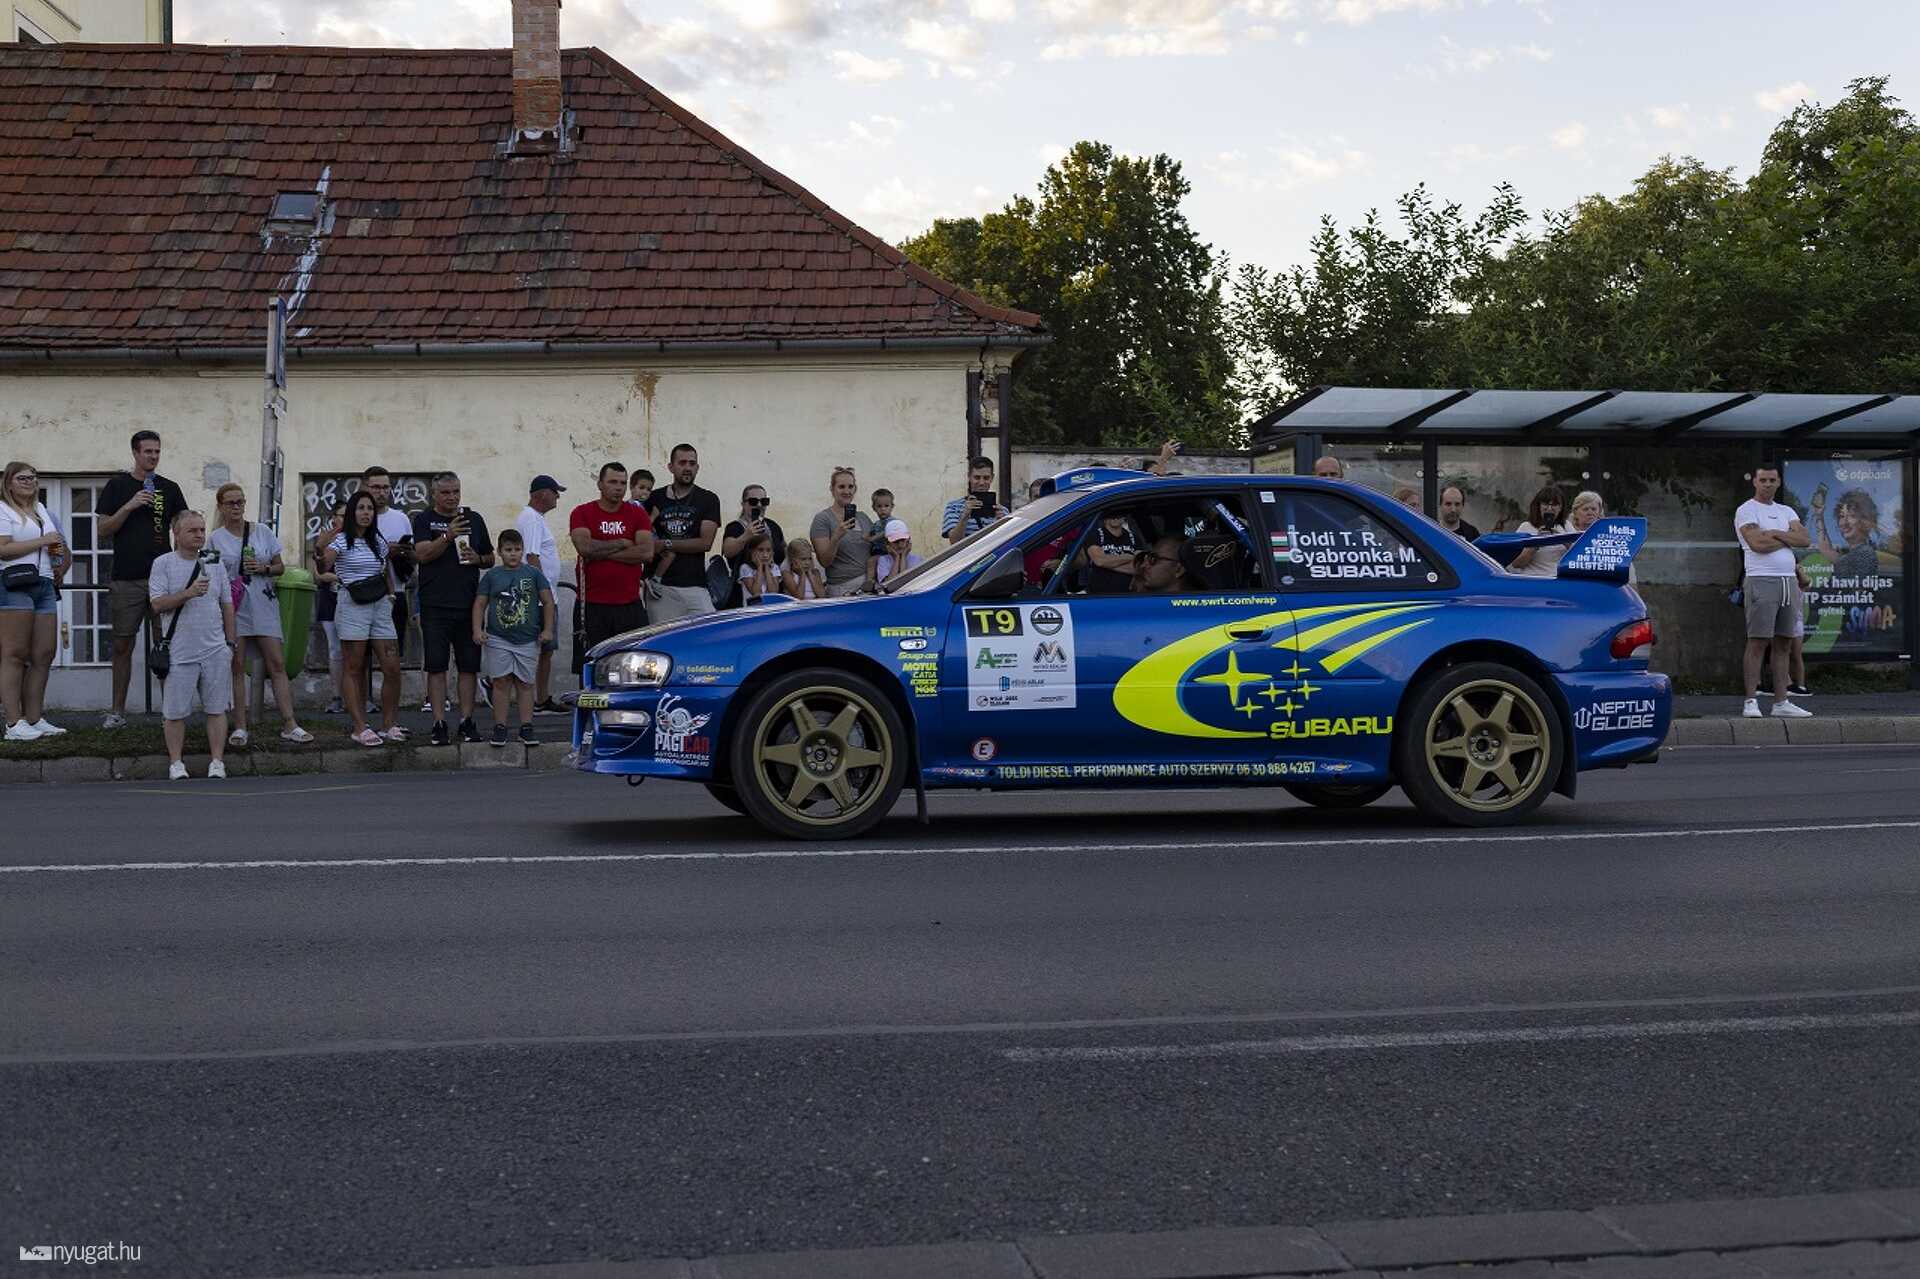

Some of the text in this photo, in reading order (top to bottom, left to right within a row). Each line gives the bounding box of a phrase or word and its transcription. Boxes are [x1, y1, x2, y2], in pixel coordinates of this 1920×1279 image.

[1287, 531, 1382, 547] Toldi T. R.
[1289, 547, 1421, 567] Gyabronka M.
[1309, 564, 1408, 579] SUBARU
[1815, 575, 1830, 588] Ft
[1832, 575, 1859, 588] havi
[1802, 590, 1875, 604] TP számlát
[971, 609, 1016, 634] T9
[903, 662, 938, 672] MOTUL
[1592, 699, 1655, 715] NEPTUN
[1270, 716, 1393, 739] SUBARU
[1592, 714, 1655, 731] GLOBE
[978, 742, 989, 756] E
[998, 765, 1031, 779] TOLDI
[1033, 765, 1072, 778] DIESEL
[1073, 764, 1156, 778] PERFORMANCE
[1158, 763, 1188, 776] AUTO
[1190, 763, 1235, 776] SZERVIZ
